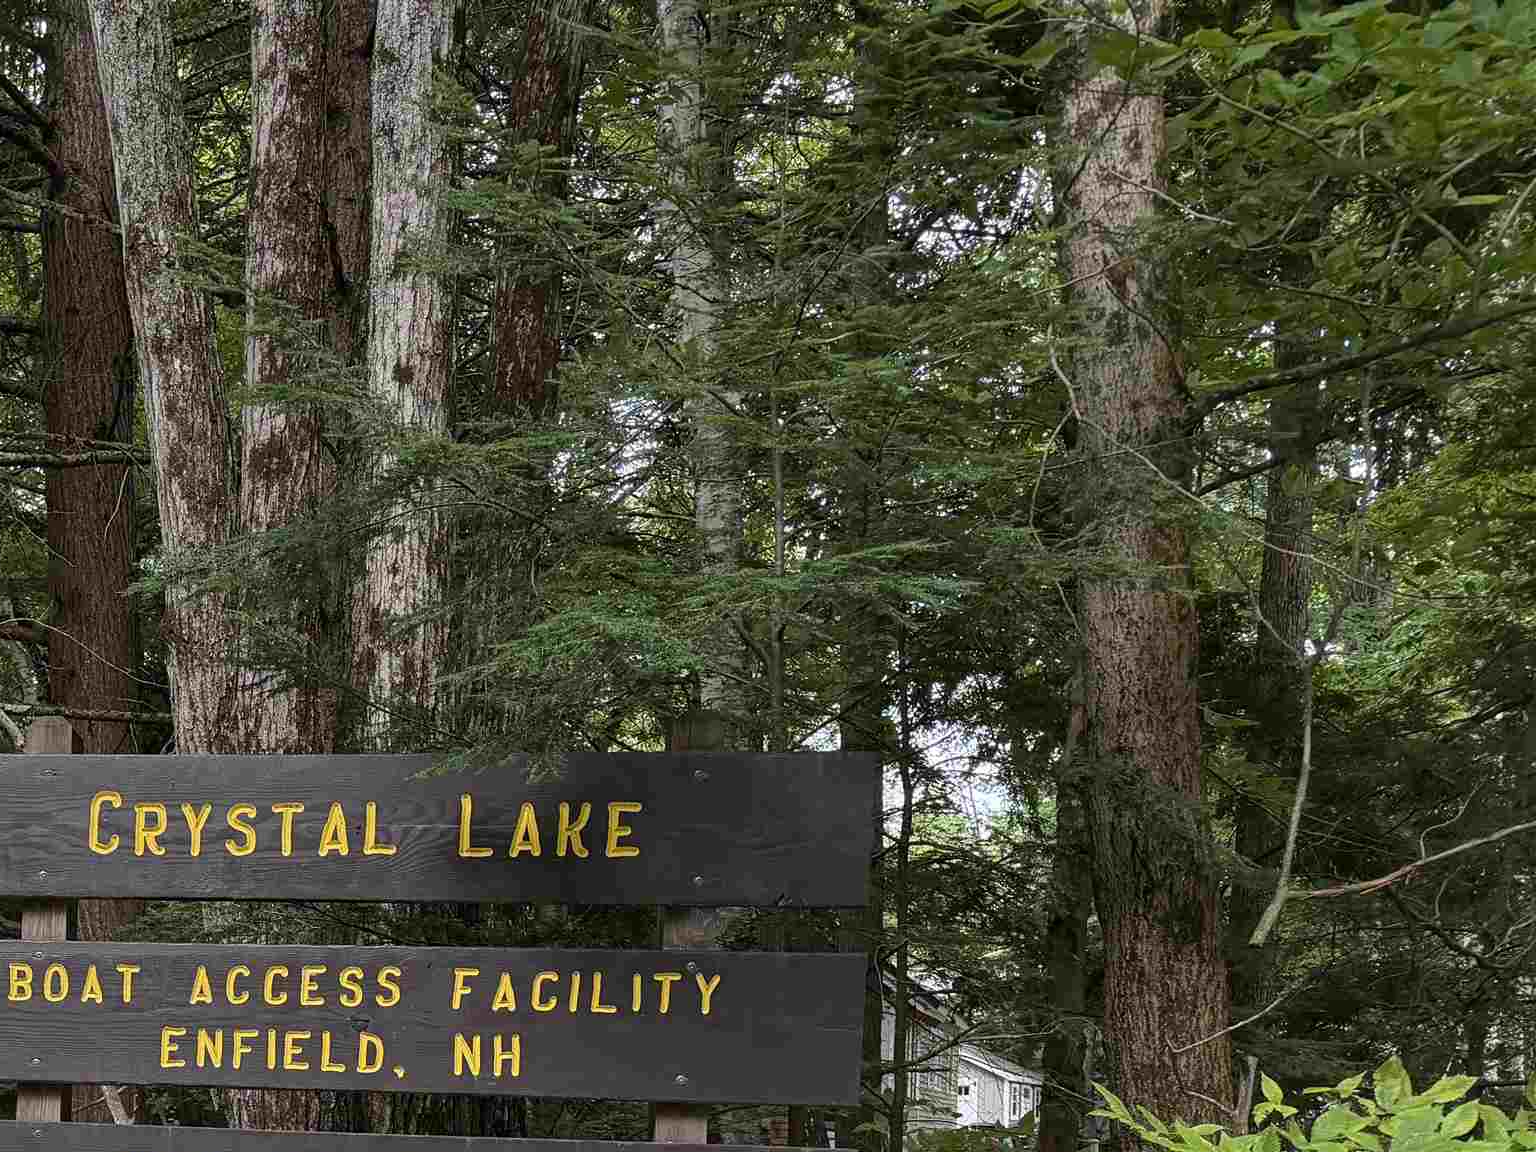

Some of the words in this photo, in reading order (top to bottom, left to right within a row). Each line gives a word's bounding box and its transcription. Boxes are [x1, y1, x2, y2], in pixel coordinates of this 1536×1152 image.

[89, 791, 396, 858] CRYSTAL
[459, 794, 642, 857] LAKE
[8, 963, 139, 1003] BOAT
[192, 965, 401, 1007] ACCESS
[452, 968, 721, 1015] FACILITY
[454, 1034, 521, 1078] NH
